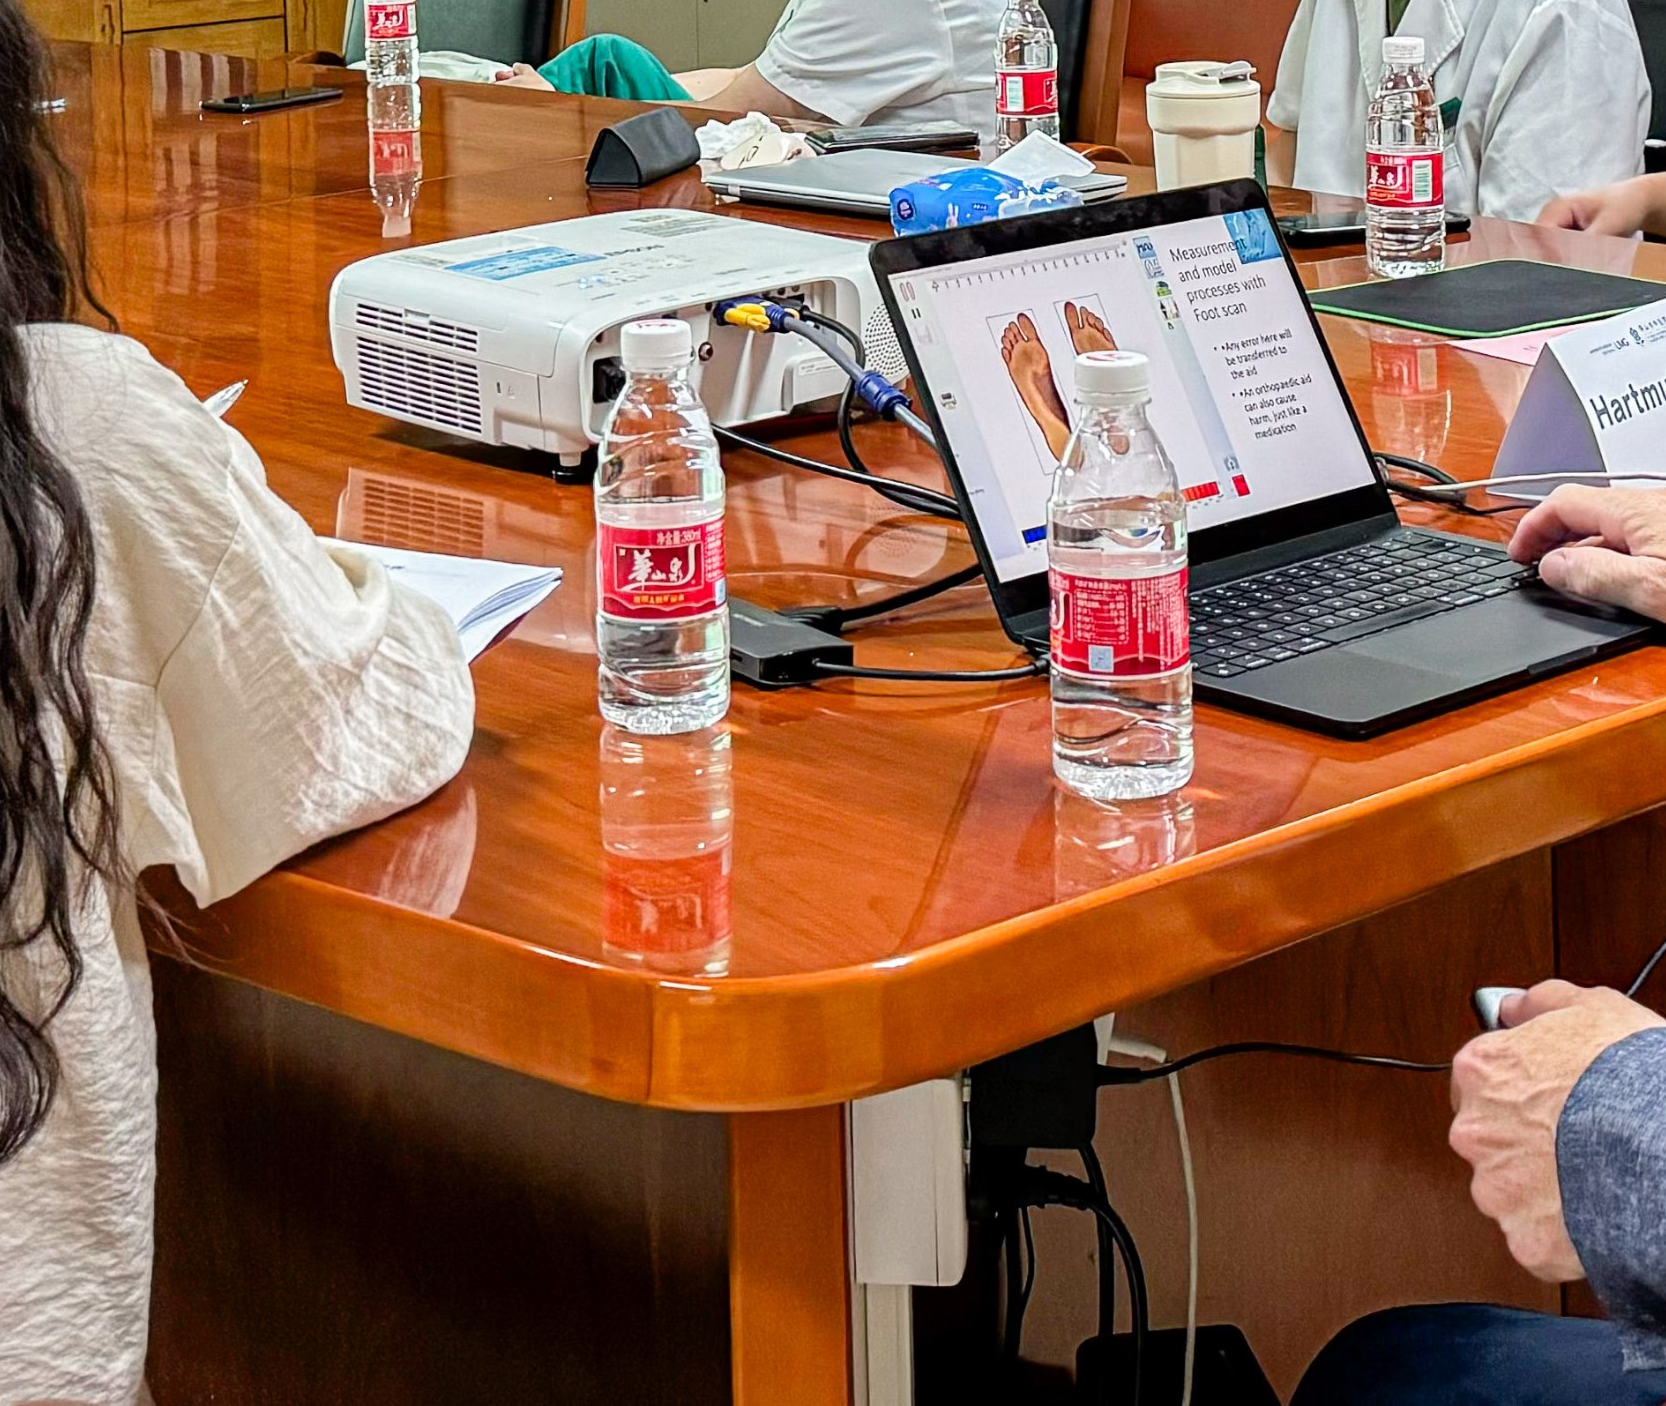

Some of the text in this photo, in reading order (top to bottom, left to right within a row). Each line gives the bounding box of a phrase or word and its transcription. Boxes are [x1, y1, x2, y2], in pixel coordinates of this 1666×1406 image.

[1169, 237, 1248, 262] Measurement
[1178, 259, 1237, 283] and model
[1186, 274, 1267, 304] processes with
[1193, 301, 1248, 322] Foot scan
[1225, 356, 1236, 366] be
[1278, 345, 1288, 354] to
[1230, 365, 1258, 380] the aid
[1301, 373, 1312, 384] aid
[1244, 393, 1297, 413] can also cause
[1287, 405, 1301, 416] like
[1254, 423, 1297, 440] medication
